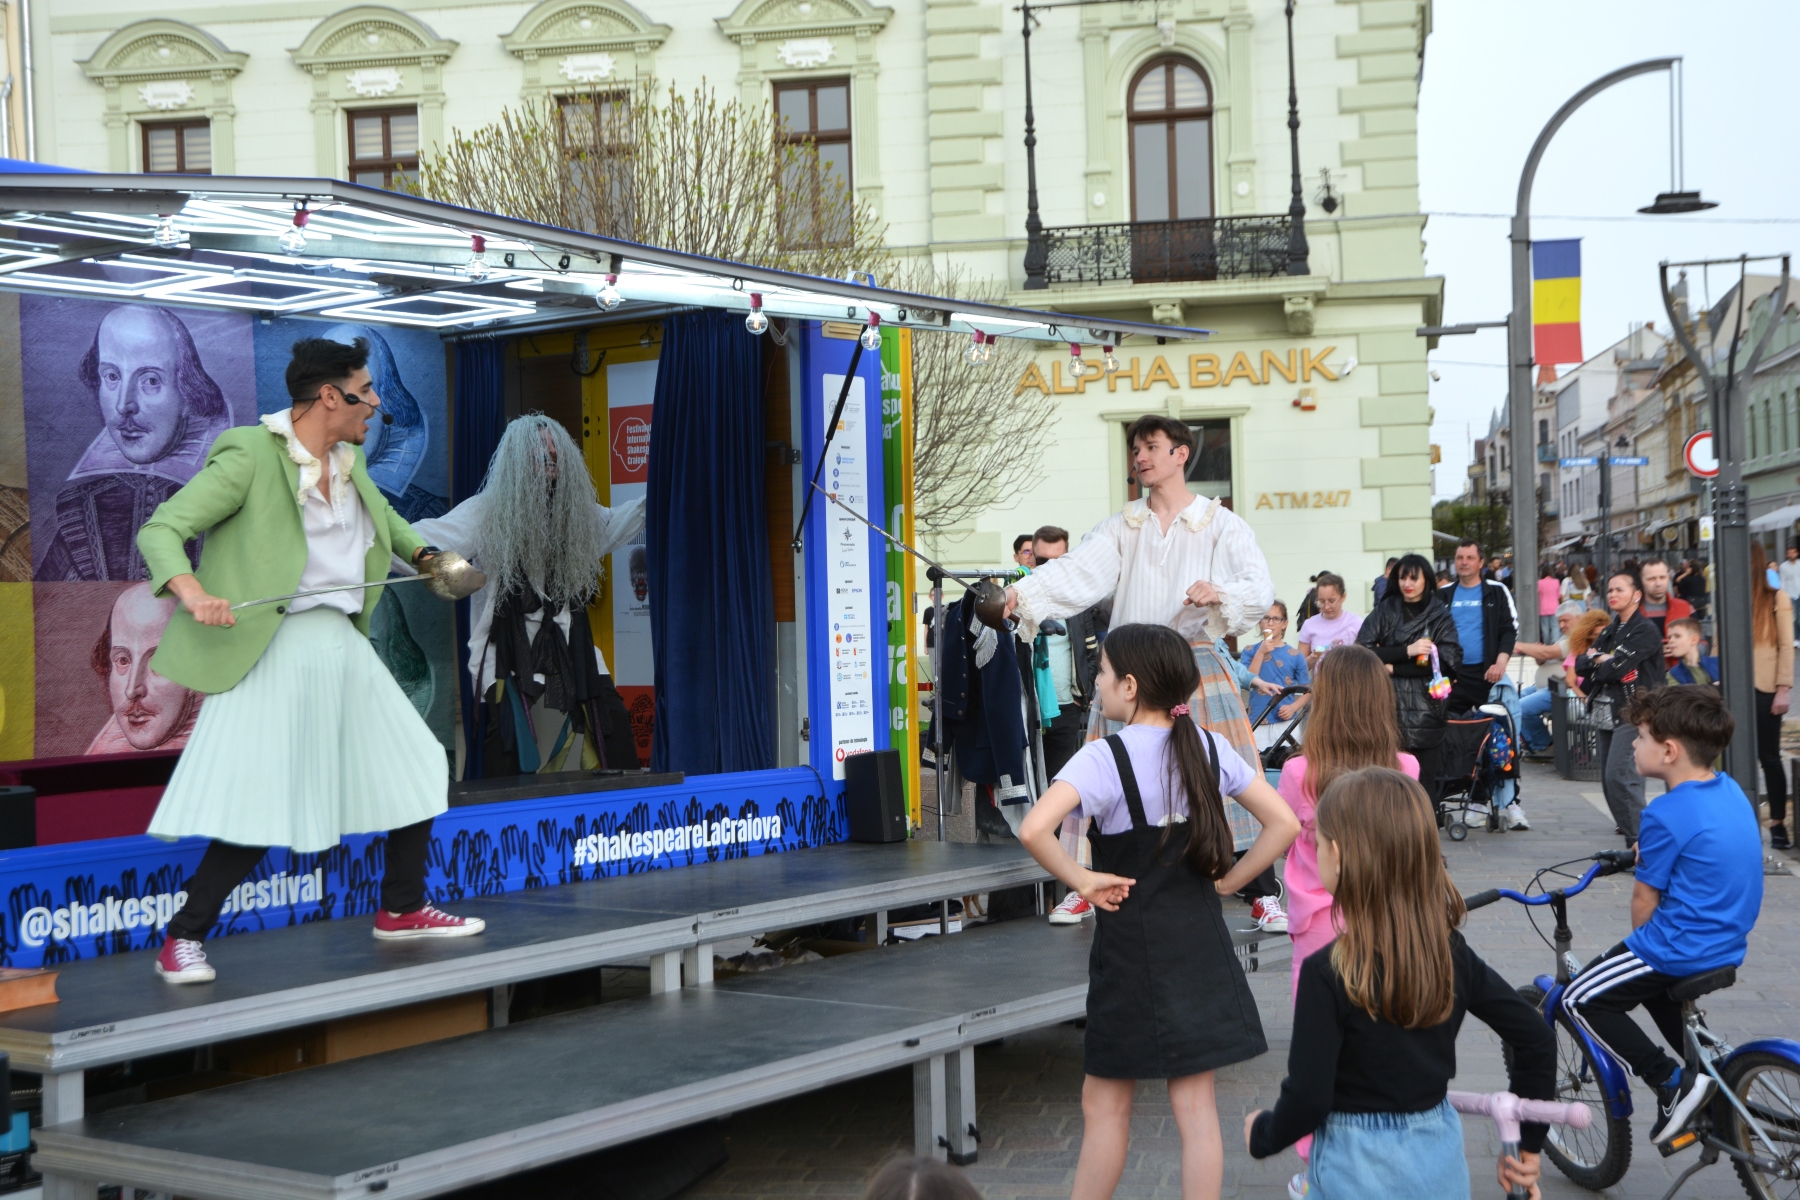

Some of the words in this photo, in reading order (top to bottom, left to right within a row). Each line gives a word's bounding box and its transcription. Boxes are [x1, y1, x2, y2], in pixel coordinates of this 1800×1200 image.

[1014, 355, 1181, 396] ALPHA
[1189, 345, 1339, 389] BANK
[626, 446, 650, 455] Shakesp
[1255, 490, 1309, 510] ATM
[1312, 489, 1351, 508] 24/7
[574, 813, 781, 867] #ShakespeareLaCraiova
